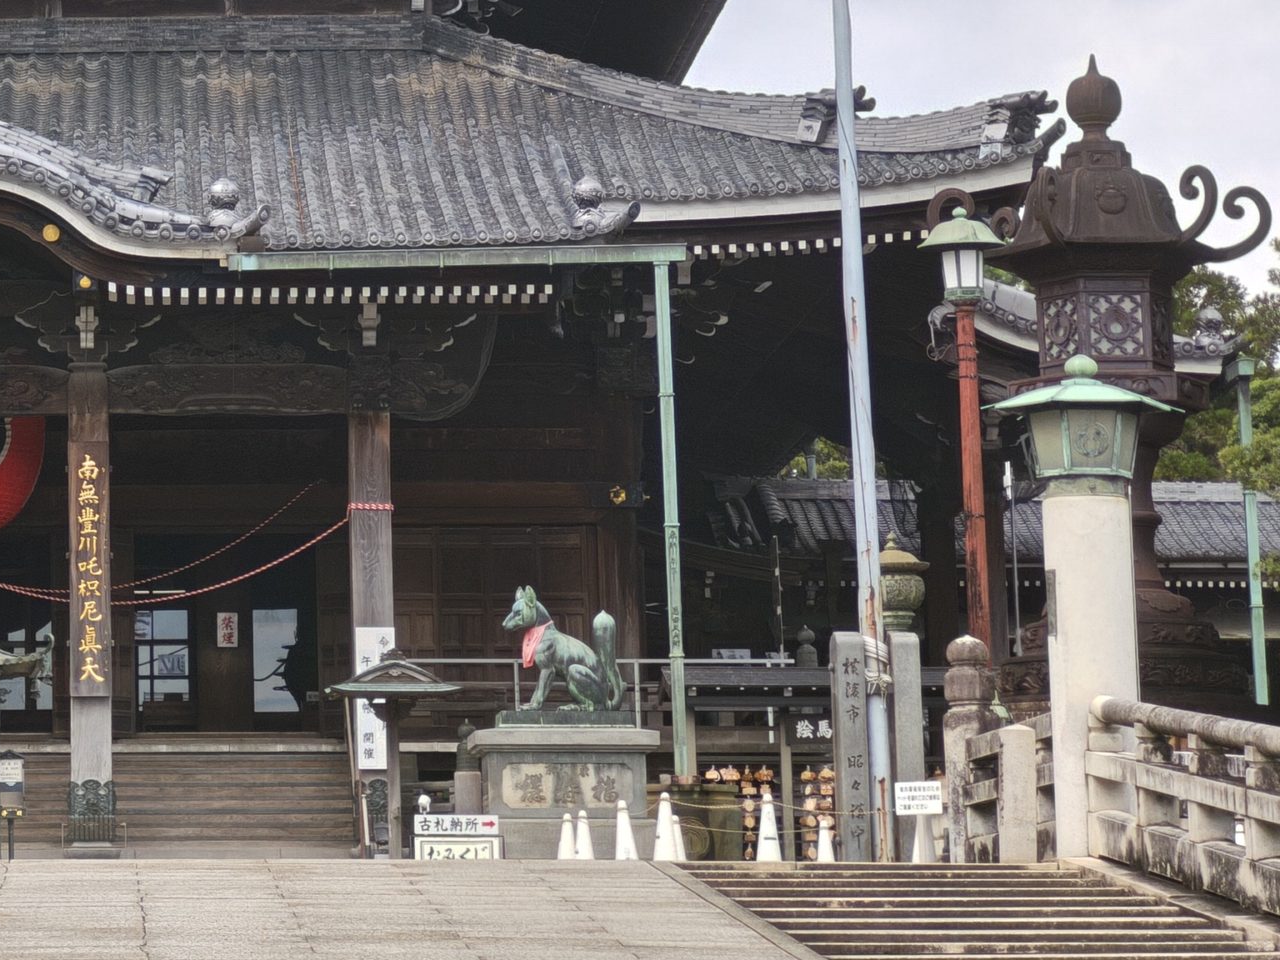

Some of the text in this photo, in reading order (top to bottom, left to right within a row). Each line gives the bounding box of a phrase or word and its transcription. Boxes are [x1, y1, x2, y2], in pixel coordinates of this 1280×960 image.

[221, 616, 234, 645] 禁煙
[795, 719, 833, 739] 絵馬
[418, 817, 479, 833] 古札納所
